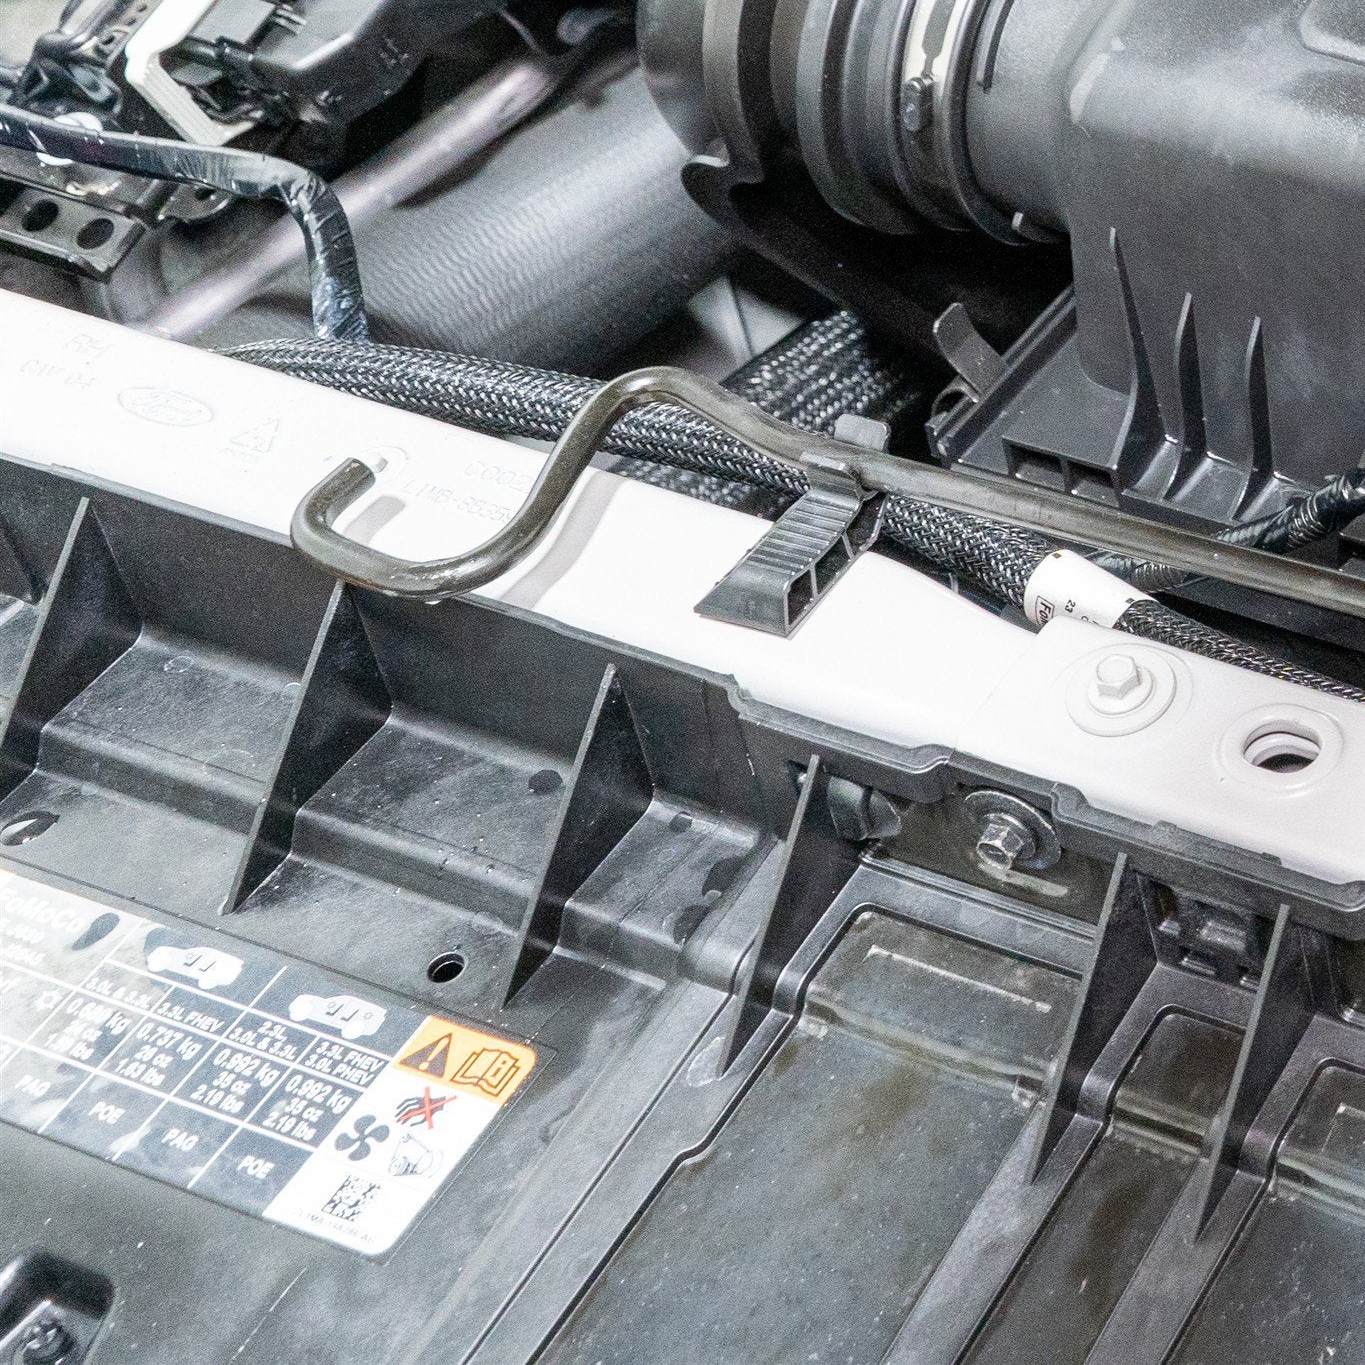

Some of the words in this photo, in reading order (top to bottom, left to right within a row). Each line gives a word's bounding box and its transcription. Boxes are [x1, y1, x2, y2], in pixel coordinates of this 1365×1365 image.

[105, 1011, 132, 1036] kg
[157, 1002, 184, 1023] 3.3L
[182, 1009, 226, 1033] FHEV
[136, 1022, 185, 1049] 0.737
[175, 1035, 203, 1061] kg
[228, 1027, 258, 1047] 3.0L
[268, 1040, 300, 1062] 3.3L
[315, 1041, 345, 1062] 3.3L
[343, 1050, 386, 1074] FHEV
[213, 1048, 262, 1077] 0.992
[253, 1061, 282, 1088] kg
[304, 1053, 334, 1074] 3.0L
[331, 1063, 376, 1086] PHEV
[284, 1074, 334, 1104] 0.992
[325, 1088, 353, 1115] kg
[88, 1101, 126, 1125] POE
[162, 1126, 198, 1153] PAG
[236, 1154, 276, 1180] POE
